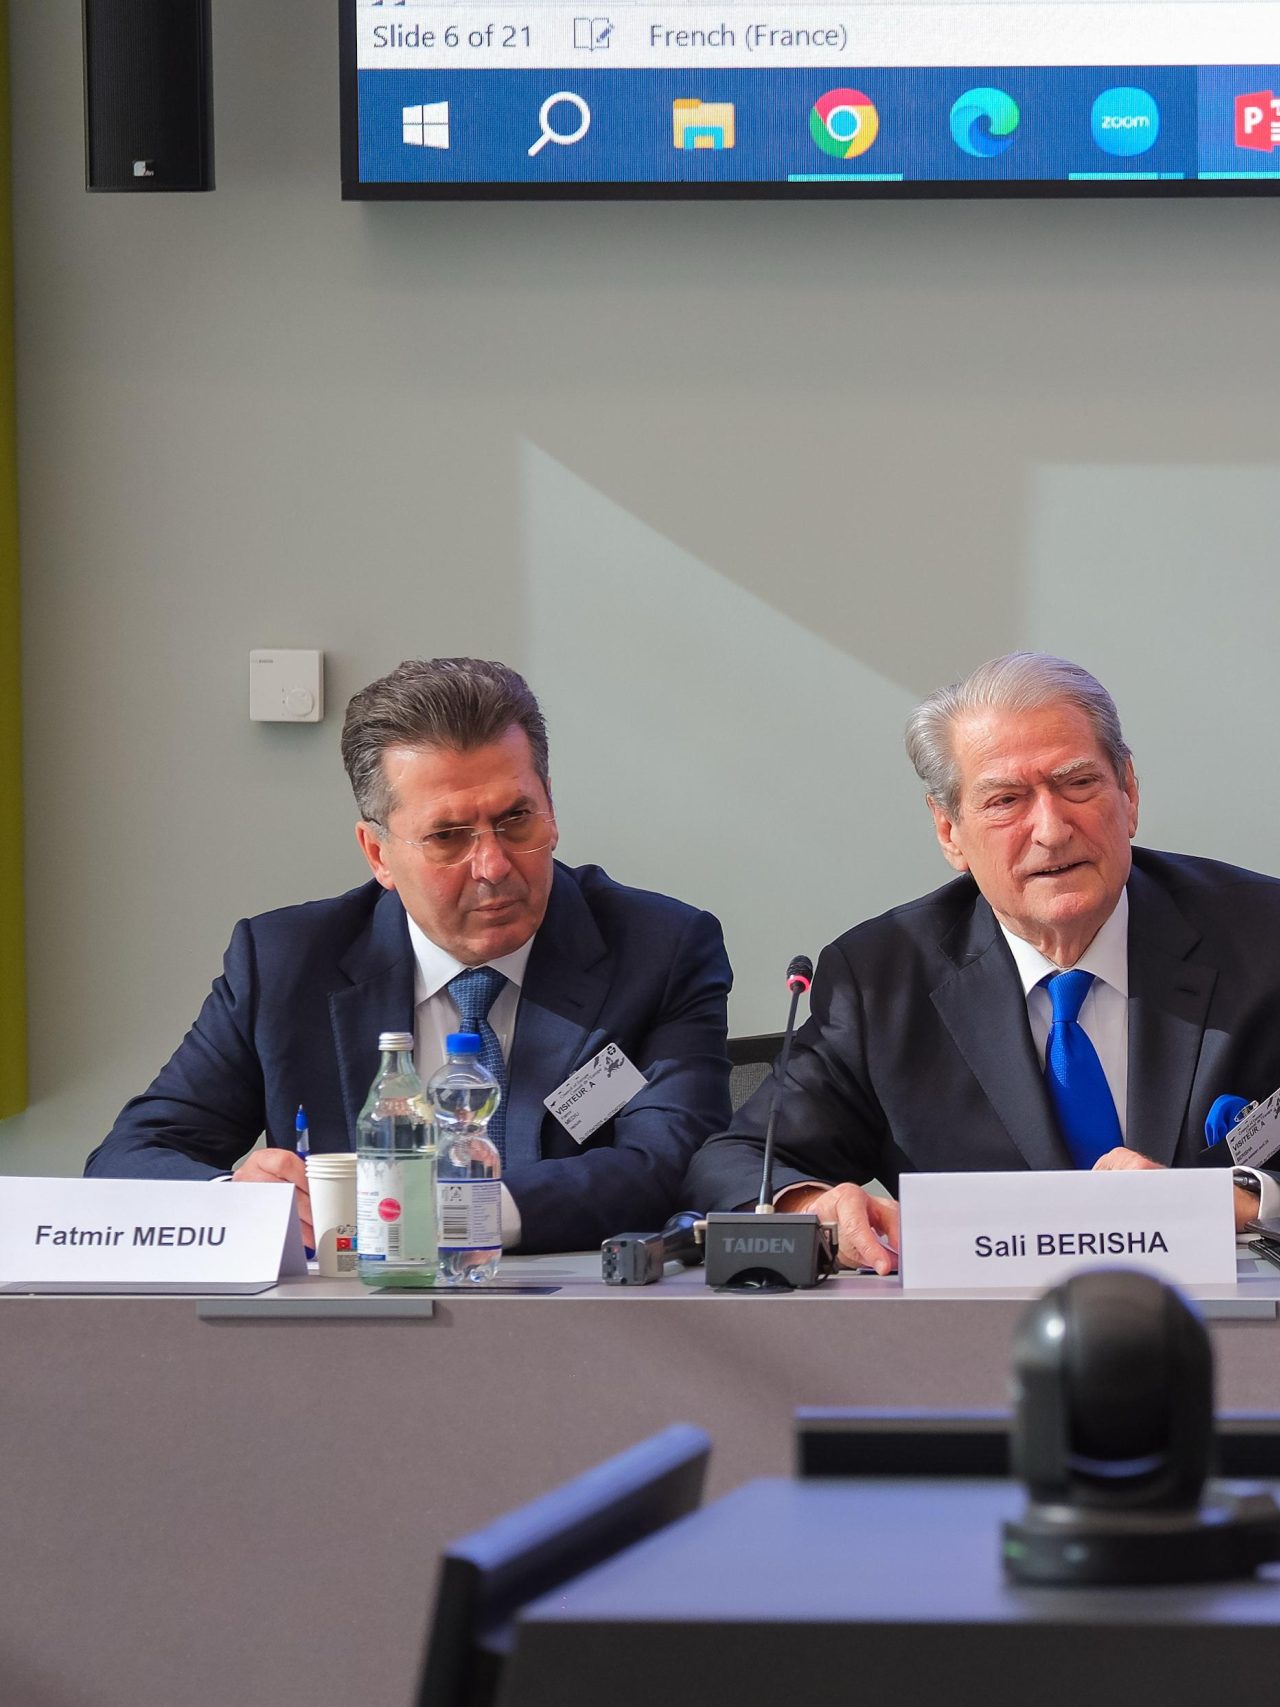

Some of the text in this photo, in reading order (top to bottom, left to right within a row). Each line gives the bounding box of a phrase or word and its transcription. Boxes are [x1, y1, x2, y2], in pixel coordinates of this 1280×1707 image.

[373, 24, 531, 48] Slide 6 of 21
[650, 23, 848, 52] French (France)
[1101, 115, 1150, 129] zoom
[555, 1087, 588, 1115] VISITEUR
[1233, 1126, 1258, 1151] VISITEUR
[35, 1225, 226, 1247] Fatmir MEDIU
[722, 1237, 796, 1254] TAIDEN
[975, 1231, 1169, 1258] Sali BERISHA
